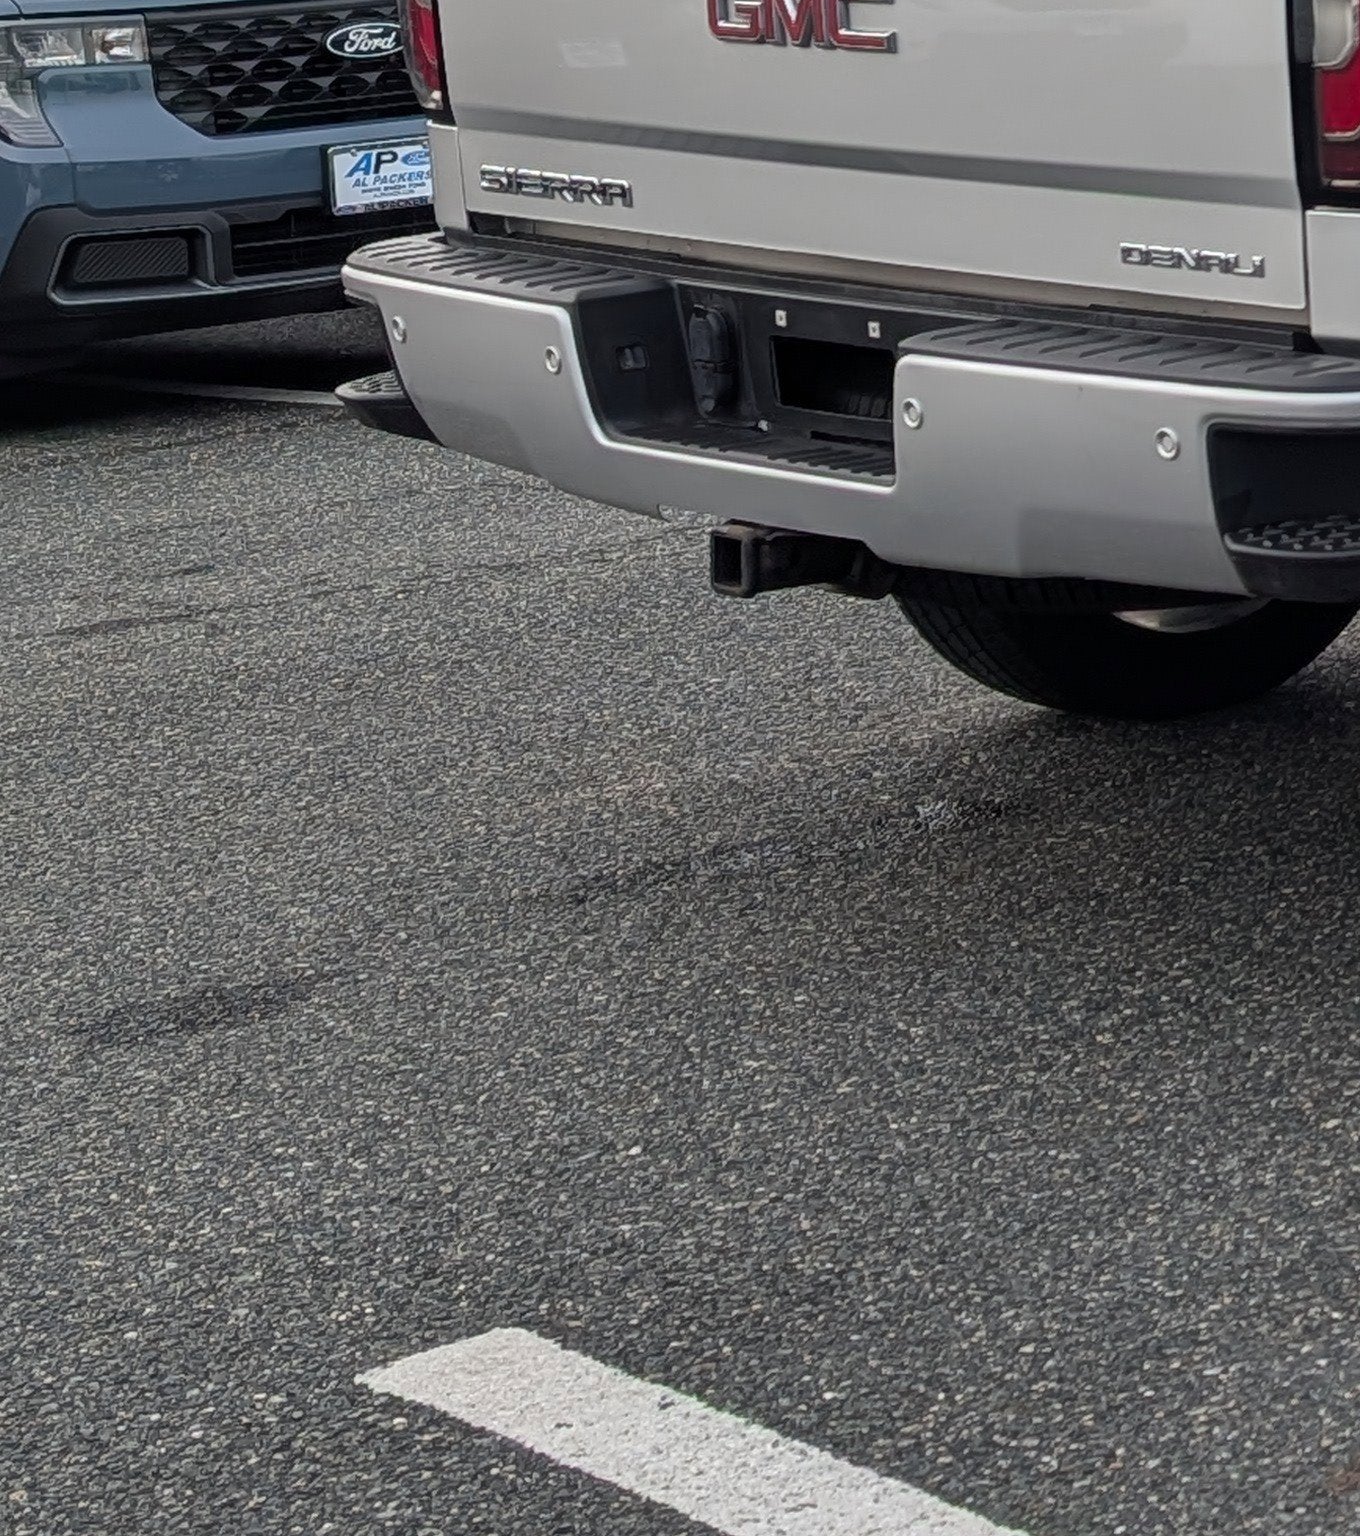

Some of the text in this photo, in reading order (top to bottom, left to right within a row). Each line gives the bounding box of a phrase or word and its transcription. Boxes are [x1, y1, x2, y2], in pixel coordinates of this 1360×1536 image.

[344, 27, 397, 53] Ford
[344, 150, 399, 179] AP
[352, 177, 369, 189] AL
[479, 164, 634, 208] SIERRA
[1120, 242, 1266, 279] DENALI
